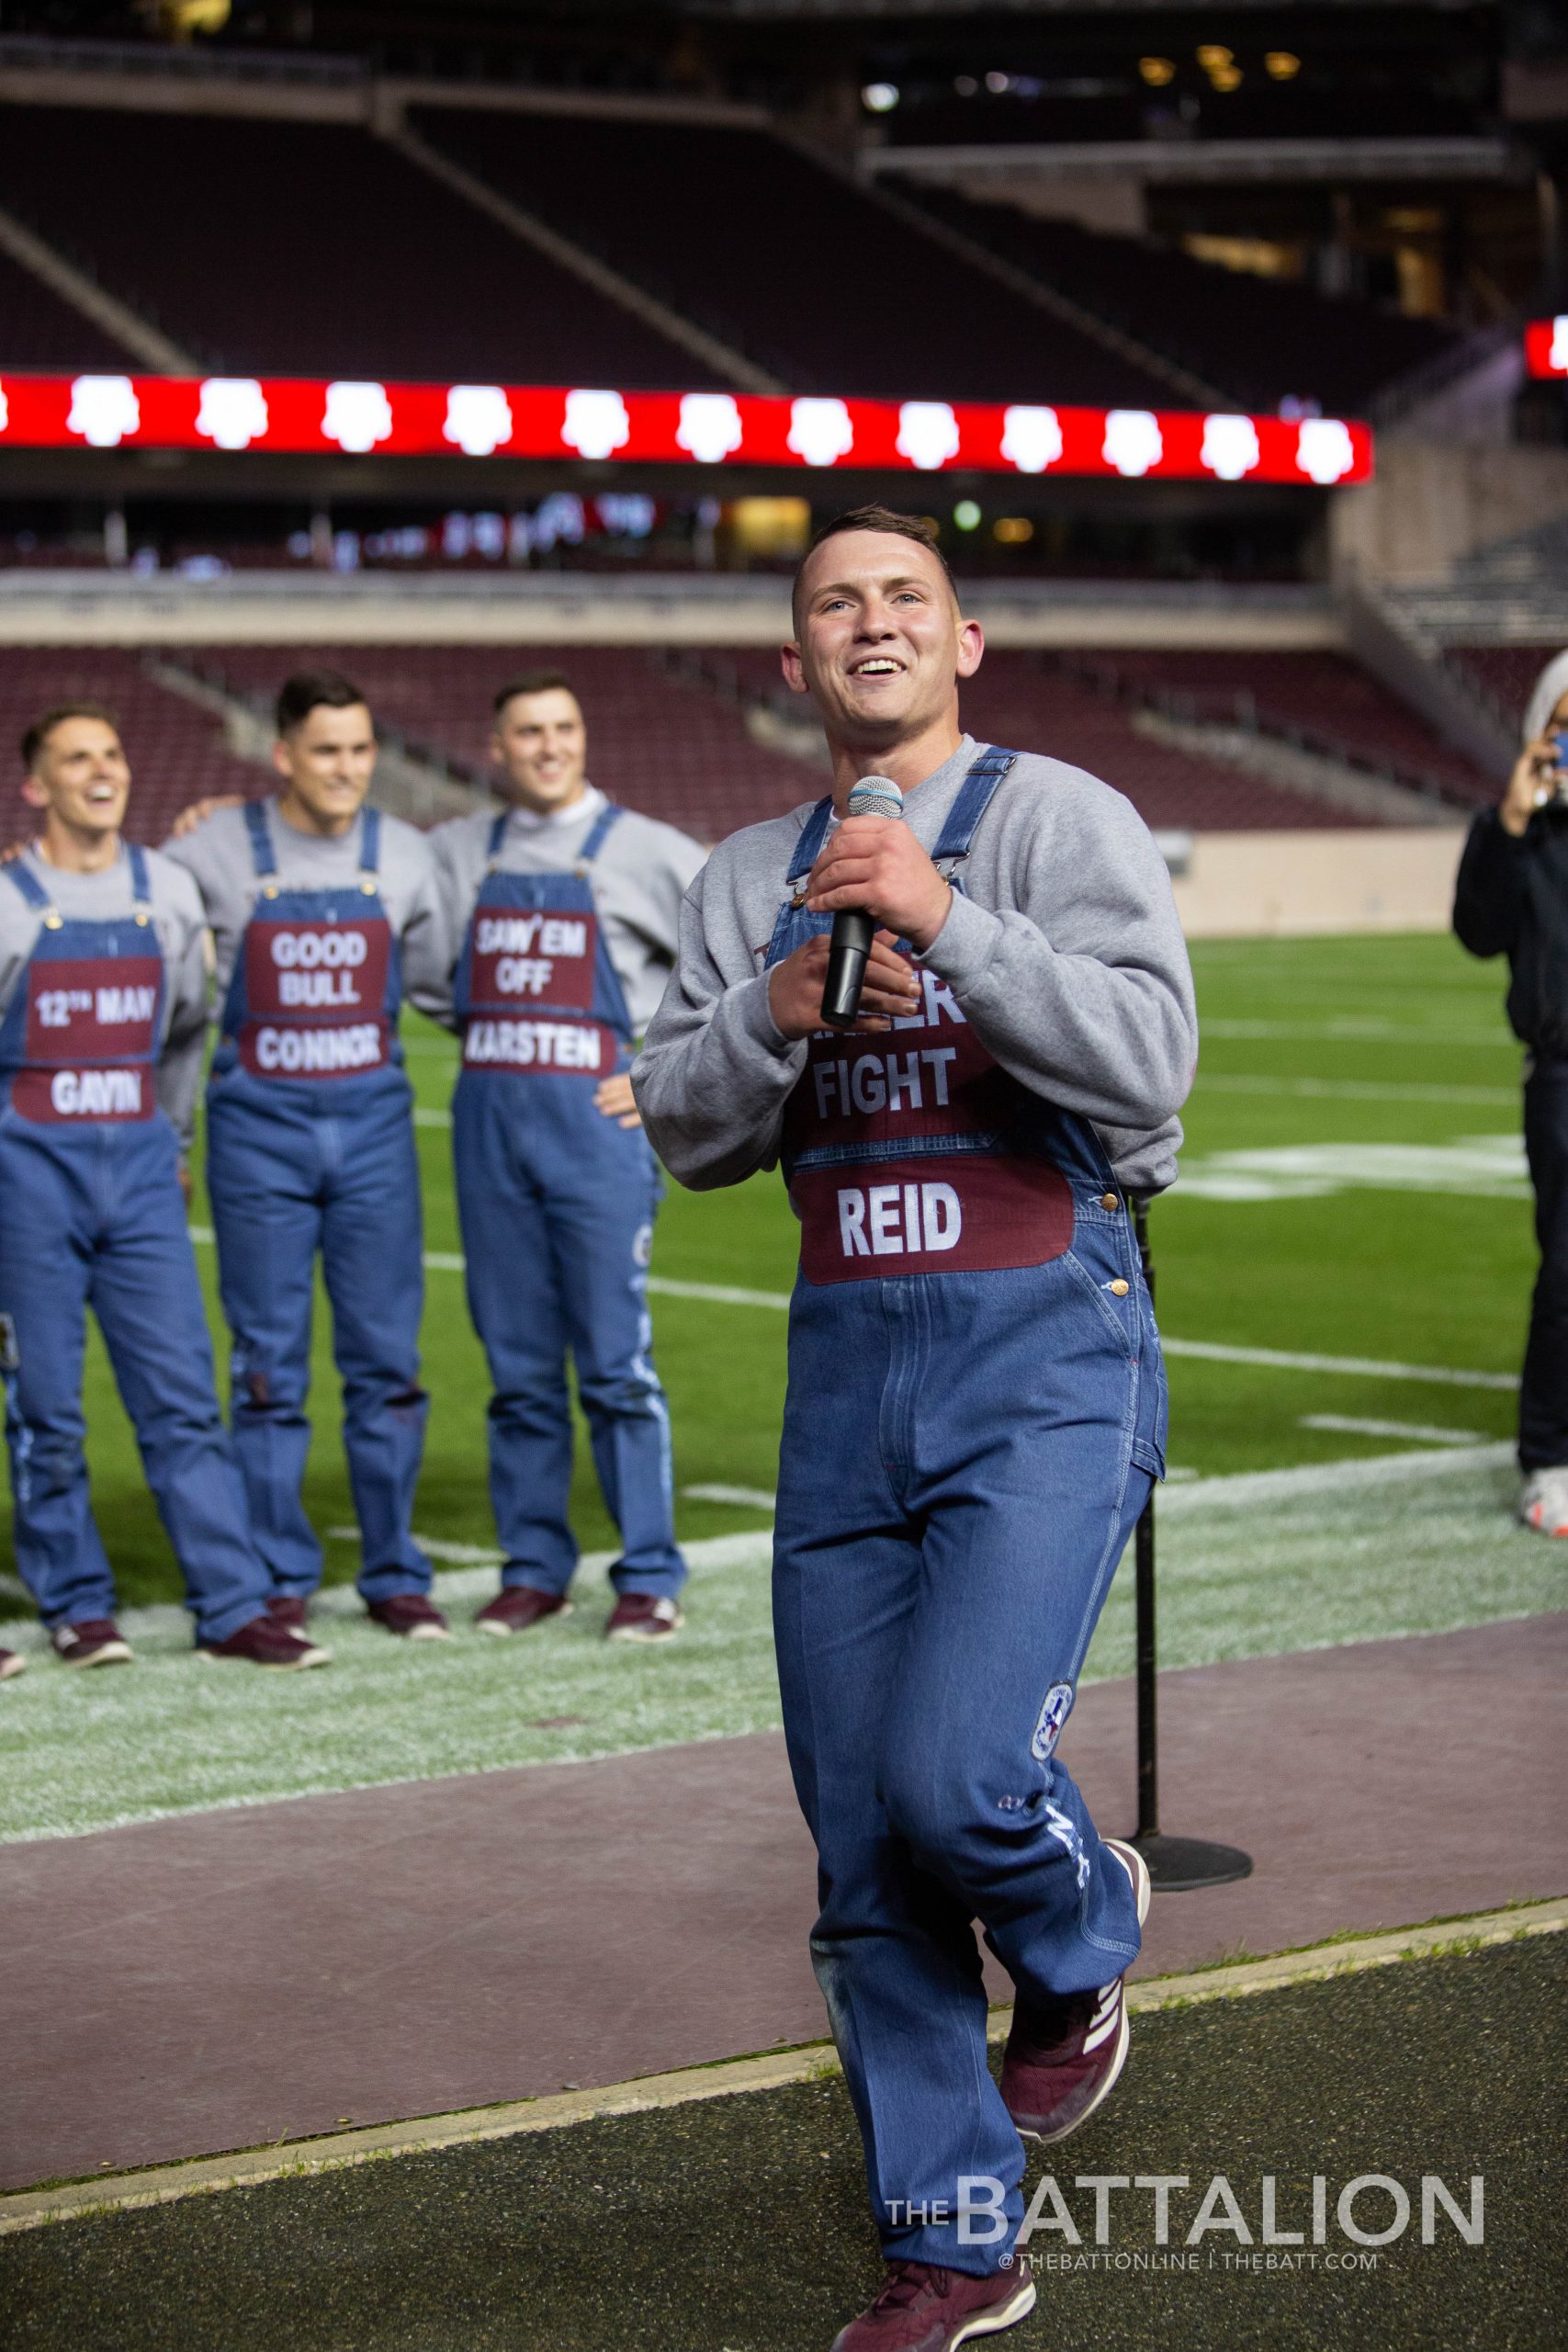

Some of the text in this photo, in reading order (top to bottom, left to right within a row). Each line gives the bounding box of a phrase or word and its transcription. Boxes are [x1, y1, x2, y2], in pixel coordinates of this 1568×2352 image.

[271, 931, 367, 967] GOOD
[278, 969, 362, 1007] BULL
[495, 956, 553, 996] OFF
[96, 985, 155, 1025] MAN
[256, 1023, 382, 1072] CONNOR
[465, 1020, 601, 1069] KARSTEN
[51, 1069, 141, 1114] GAVIN
[813, 1046, 957, 1119] FIGHT
[838, 1182, 962, 1257] REID
